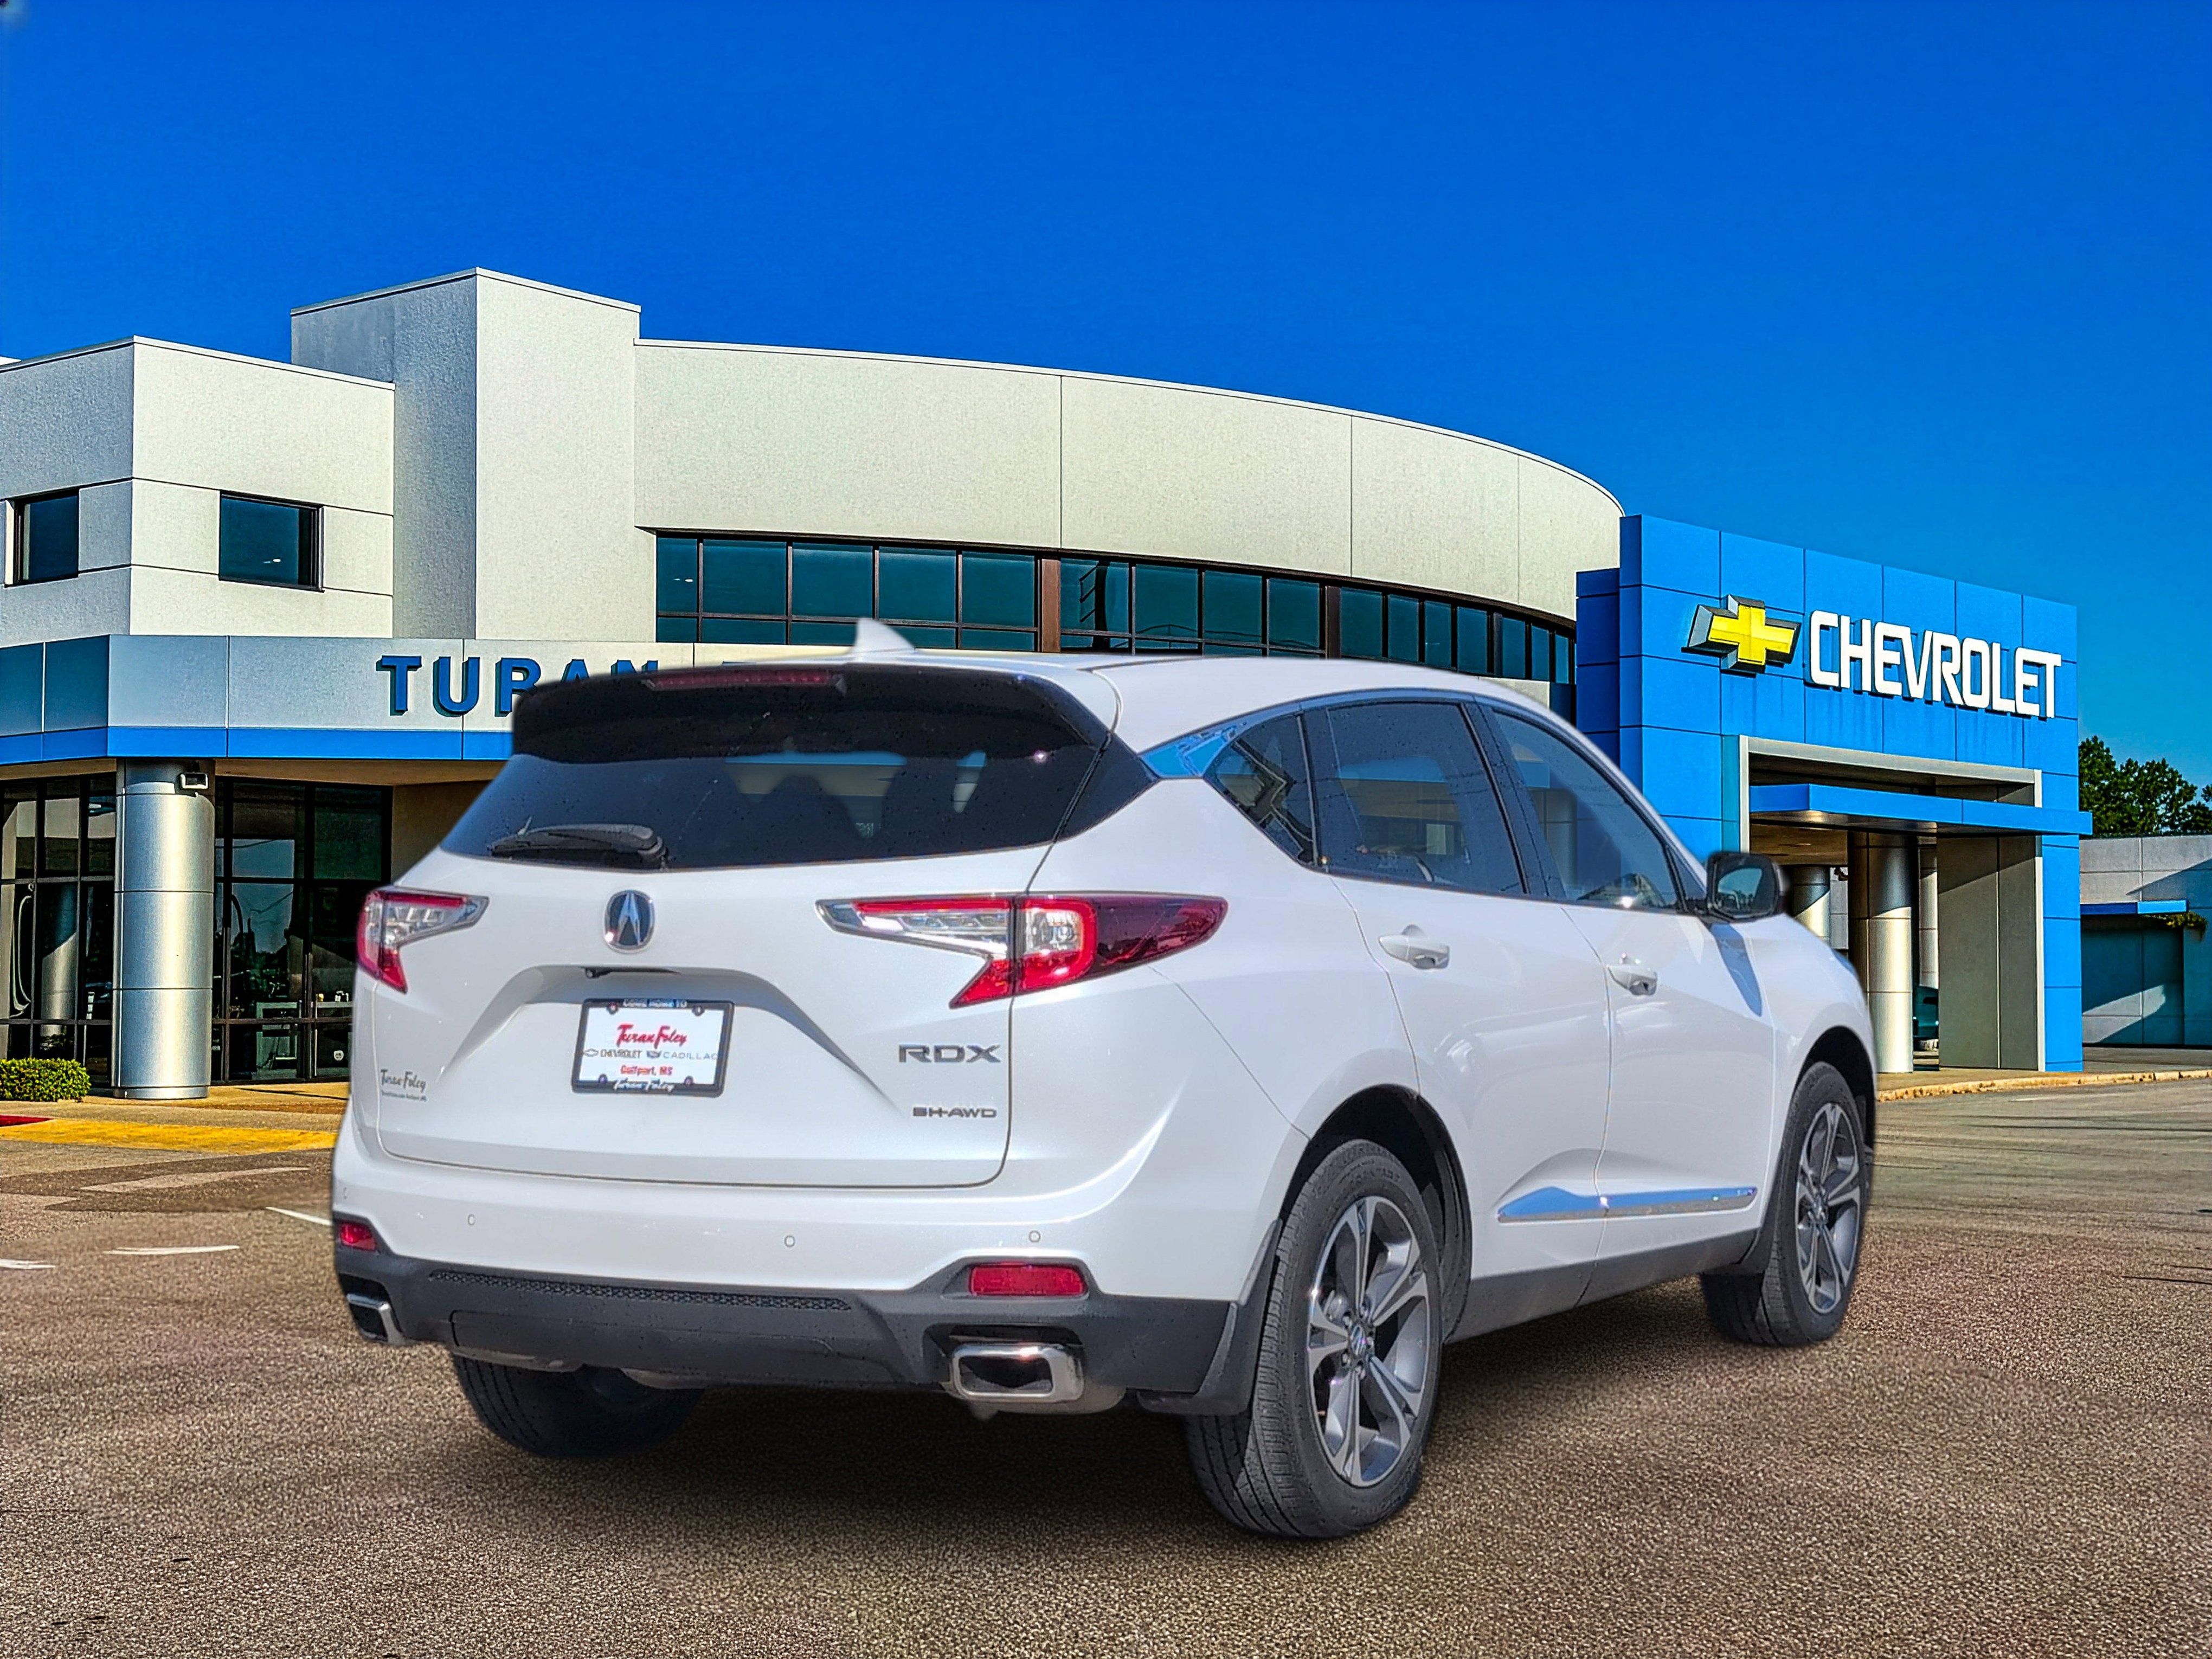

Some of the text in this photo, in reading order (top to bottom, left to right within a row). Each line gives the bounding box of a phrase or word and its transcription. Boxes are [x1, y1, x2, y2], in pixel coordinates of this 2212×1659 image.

[1809, 610, 2061, 718] CHEVROLET
[376, 655, 659, 717] TUR
[616, 1024, 687, 1049] Turan Foley
[663, 1051, 718, 1060] CADILLAC
[899, 1045, 1001, 1063] RDX
[659, 1066, 673, 1076] MS
[912, 1107, 997, 1118] SH-AWD
